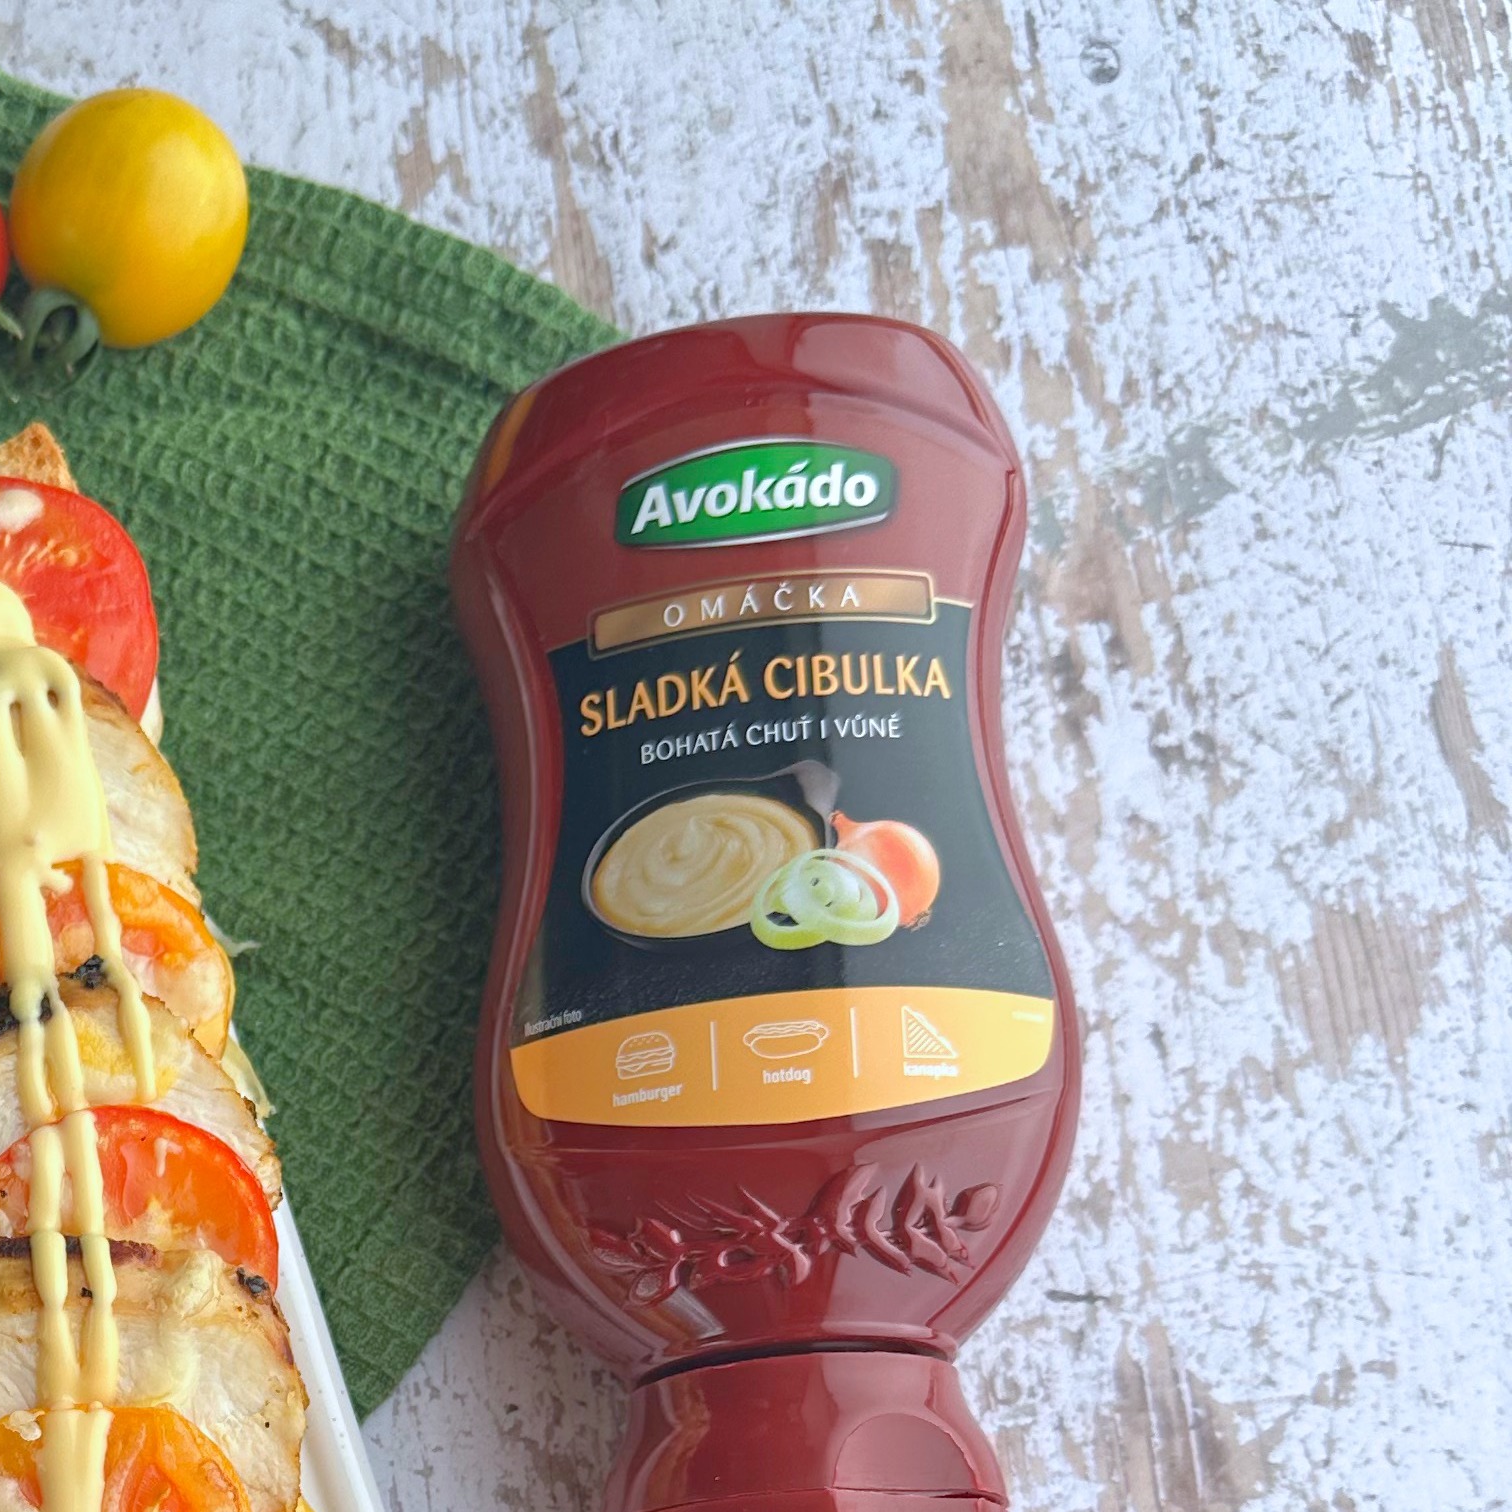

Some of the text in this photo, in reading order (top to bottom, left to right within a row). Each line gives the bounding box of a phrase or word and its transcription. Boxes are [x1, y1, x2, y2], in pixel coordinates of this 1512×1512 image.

[631, 459, 878, 535] Avokádo
[663, 583, 860, 627] OMÁČKA
[580, 651, 951, 737] SLADKÁ CIBULKA
[640, 714, 901, 765] BOHATÁ CHUŤ I VŮNĚ
[612, 1083, 683, 1107] hamburger
[763, 1067, 811, 1084] hotdog
